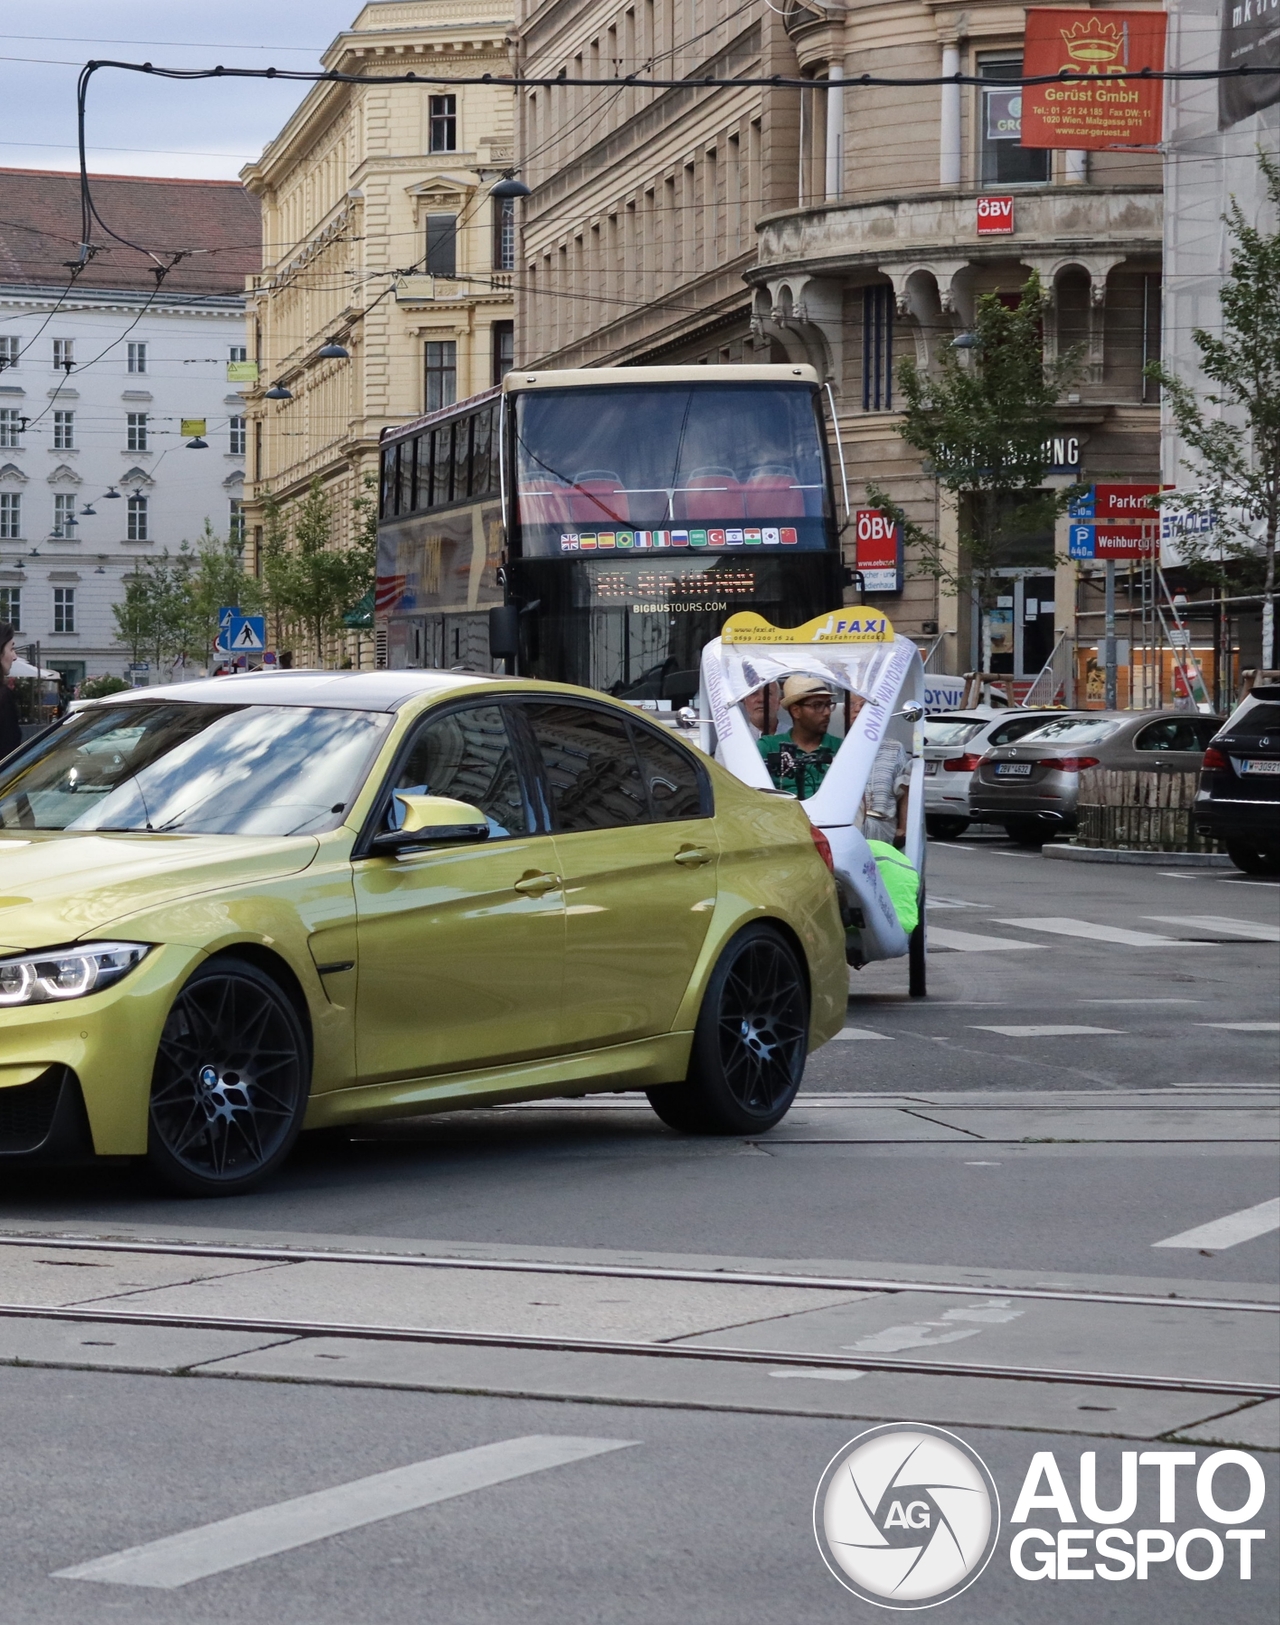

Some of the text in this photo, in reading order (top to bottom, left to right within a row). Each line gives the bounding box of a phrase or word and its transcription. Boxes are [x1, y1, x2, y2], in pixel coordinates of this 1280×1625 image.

[1059, 64, 1127, 87] CAR
[1045, 88, 1139, 103] Gerüst GmbH
[1067, 107, 1076, 115] 21
[1090, 108, 1103, 116] 185
[1109, 108, 1123, 117] Fax
[1125, 109, 1141, 117] DW:
[1042, 116, 1060, 124] 1020
[1062, 116, 1084, 125] Wien,
[1086, 117, 1125, 127] Malzgasse
[1055, 127, 1130, 137] www.car-geruest.at
[978, 200, 1011, 216] ÖBV
[858, 513, 895, 540] ÖBV
[1098, 535, 1160, 551] Weihburggs
[863, 571, 879, 579] ücher
[633, 602, 727, 613] BIGBUSTOURS.COM
[734, 626, 776, 634] www.faxi.at
[836, 619, 886, 634] FAXI
[884, 669, 899, 686] TO
[875, 681, 897, 703] WAY
[864, 718, 881, 741] ON
